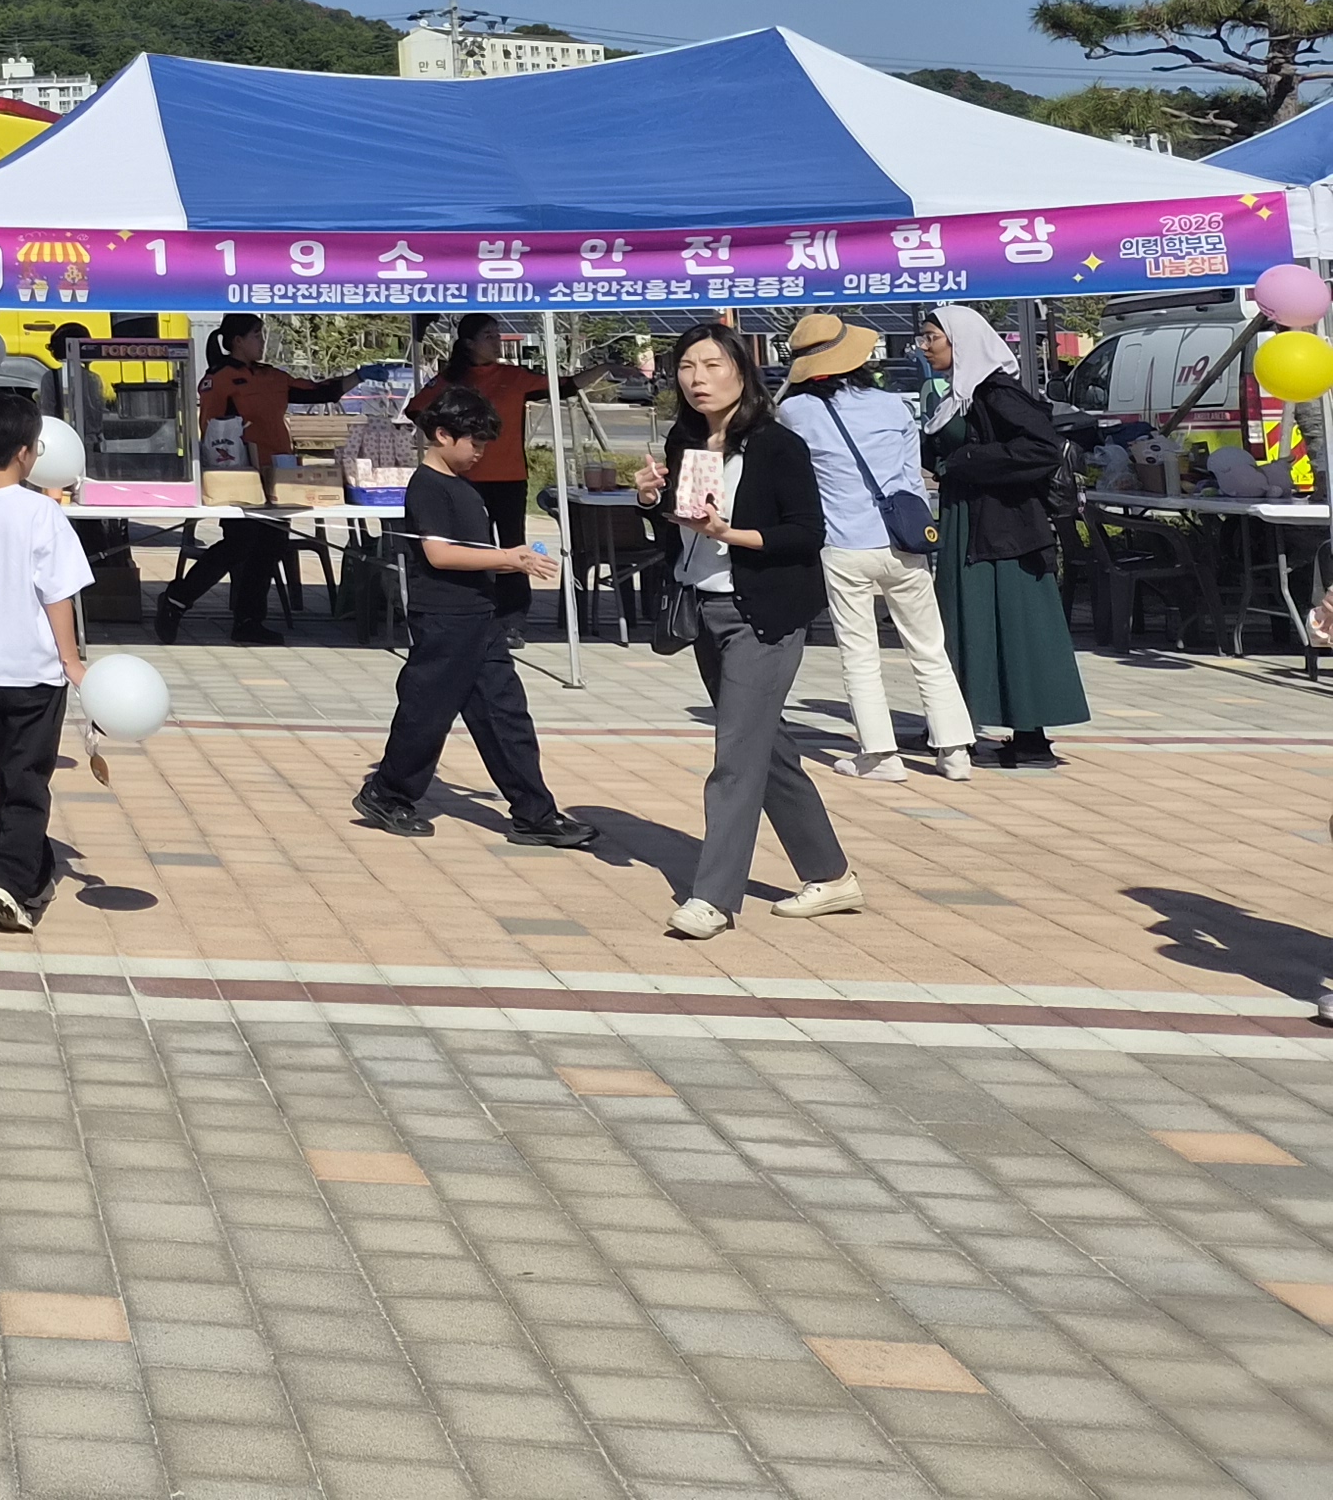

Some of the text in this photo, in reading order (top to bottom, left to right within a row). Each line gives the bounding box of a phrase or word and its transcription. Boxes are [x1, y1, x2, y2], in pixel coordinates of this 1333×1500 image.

[1158, 213, 1225, 235] 2026
[1120, 232, 1227, 258] 의령 학부모
[1146, 255, 1229, 279] 나눔장터
[227, 283, 469, 304] 이동안전체험차량(지진
[476, 282, 541, 303] 대피),
[548, 279, 701, 302] 소방안전홍보,
[707, 276, 805, 298] 팝콘증정
[842, 270, 967, 295] 의령소방서
[101, 344, 169, 357] POPCORN
[1176, 355, 1210, 383] 119
